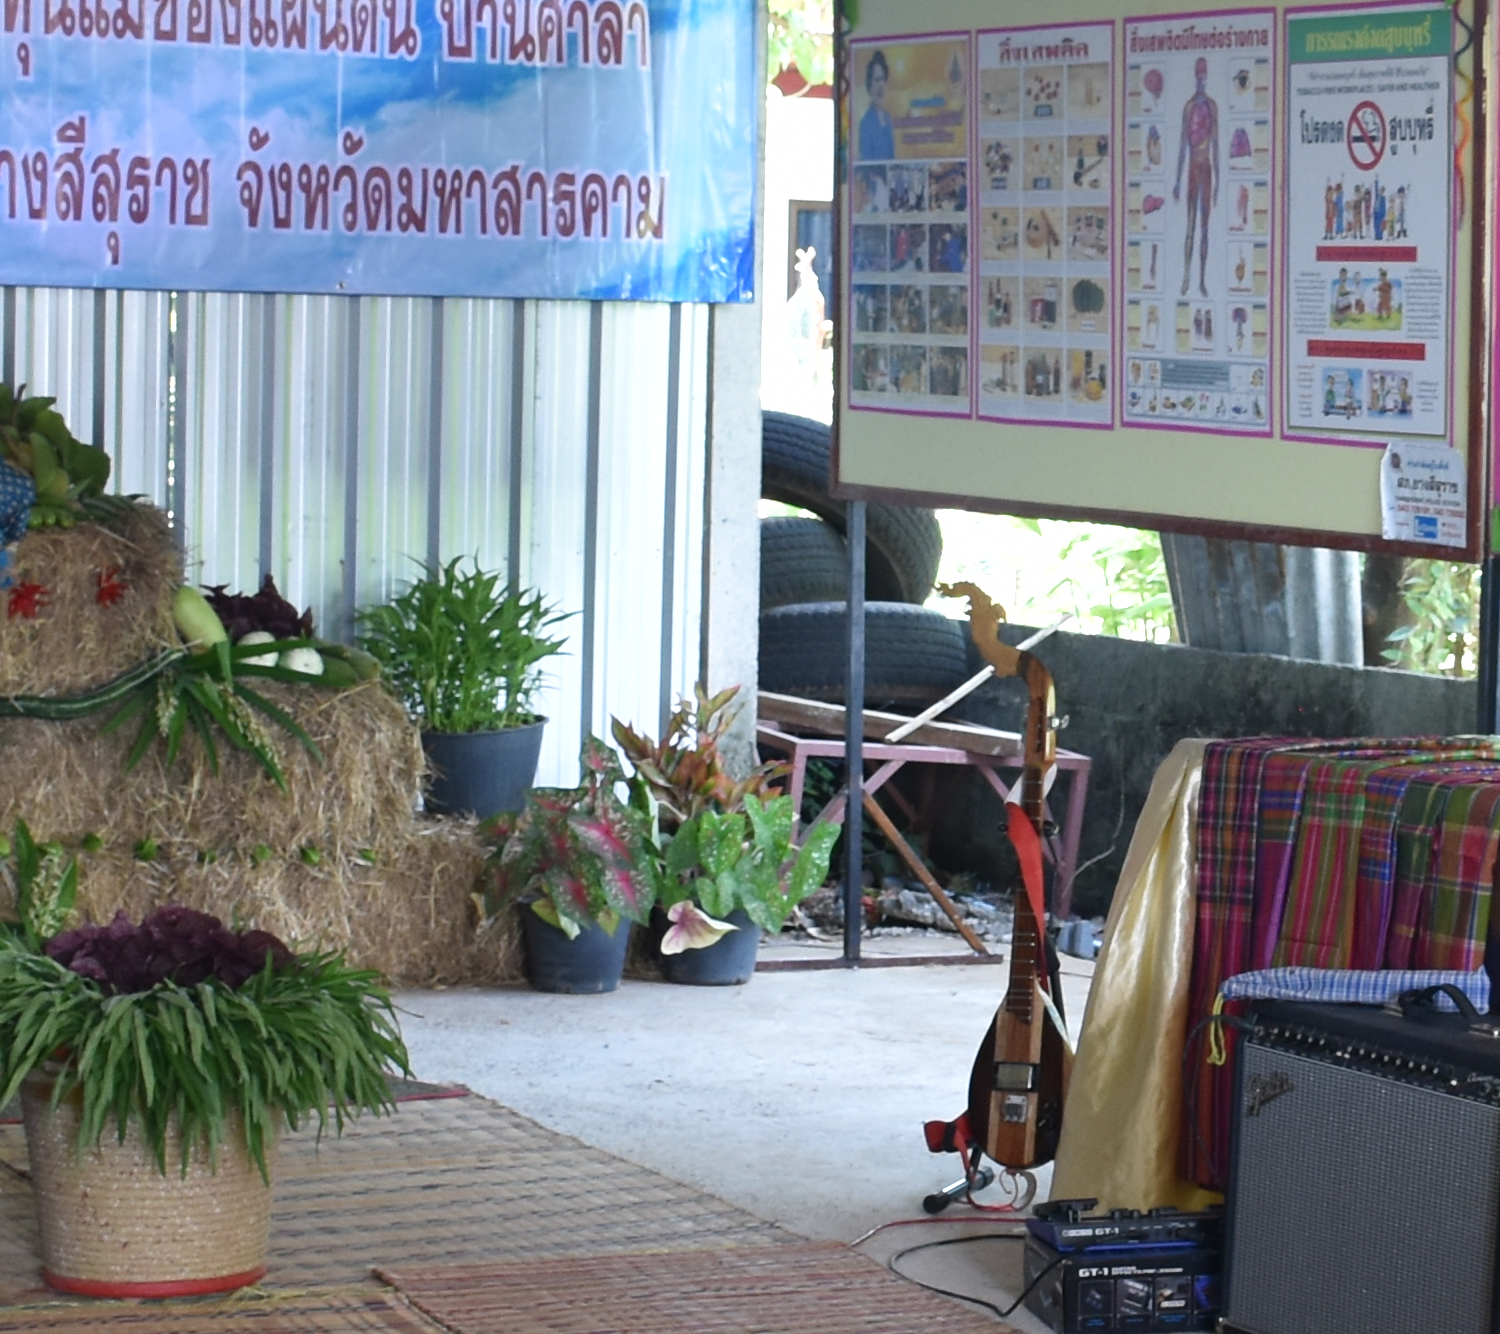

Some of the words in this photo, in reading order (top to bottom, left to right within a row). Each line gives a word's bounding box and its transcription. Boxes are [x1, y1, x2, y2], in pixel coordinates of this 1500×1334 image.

[236, 125, 667, 240] จังหวัดมหาสารคาม
[1078, 1267, 1109, 1278] GT-1
